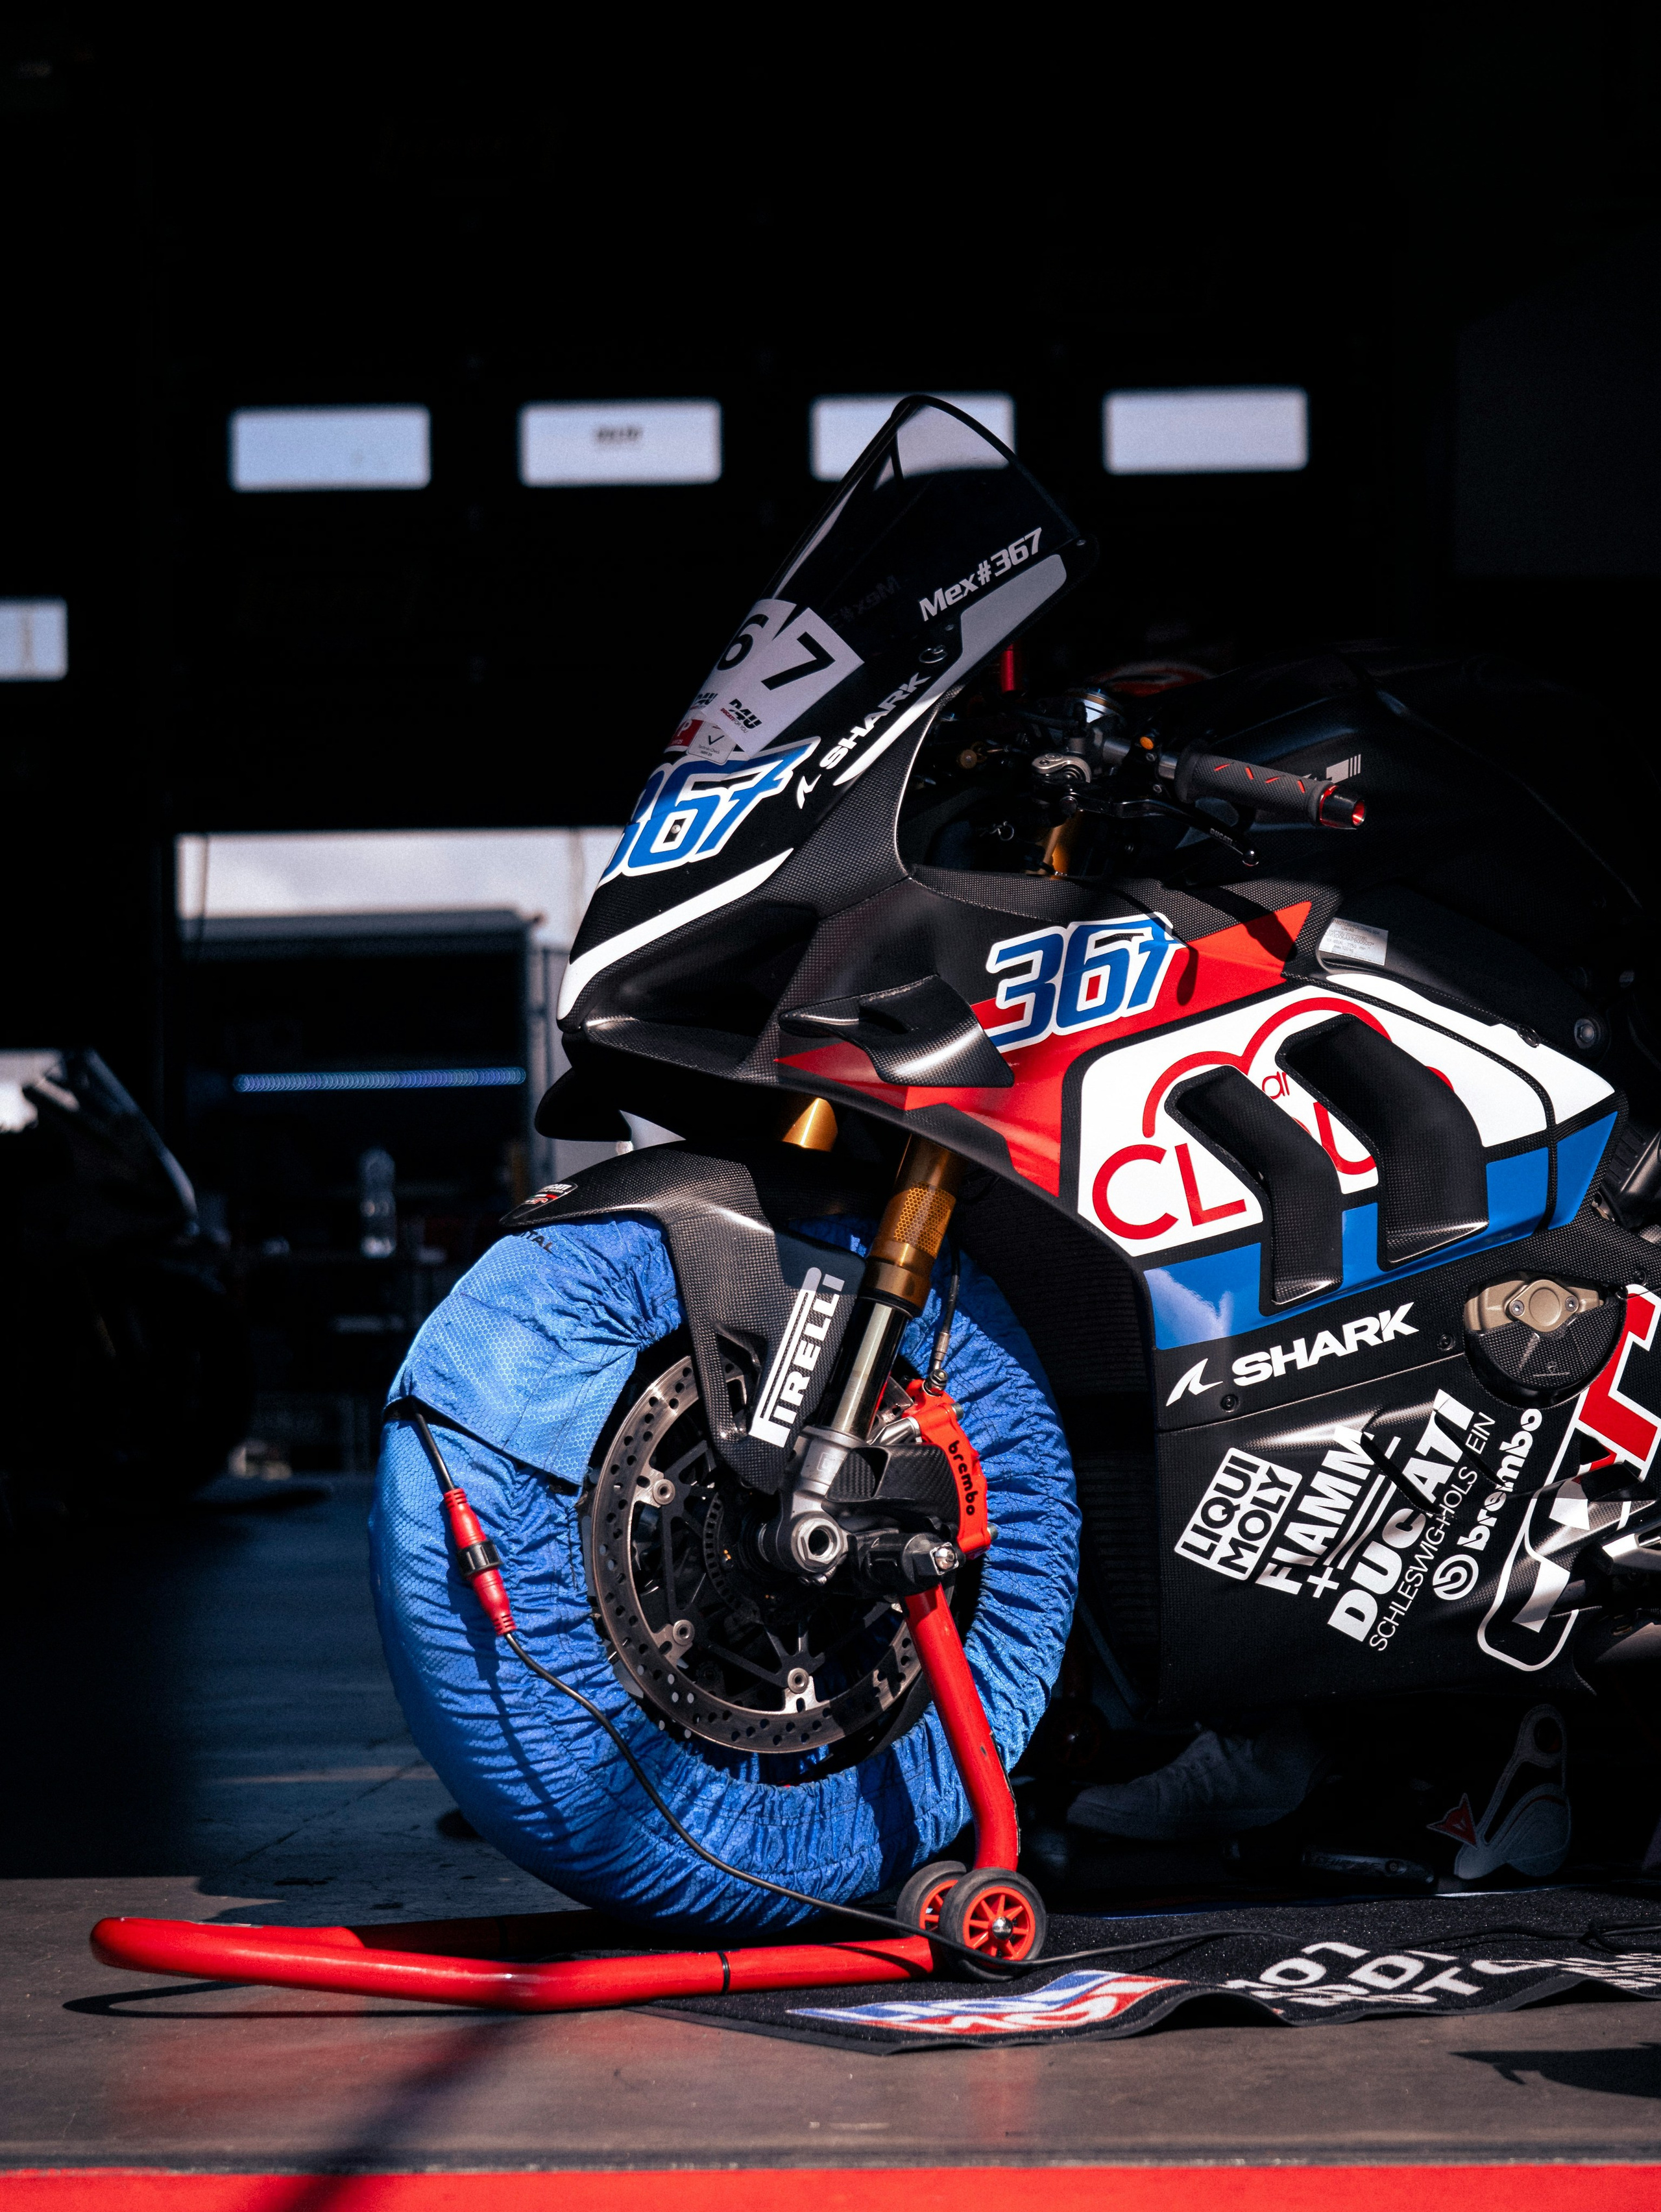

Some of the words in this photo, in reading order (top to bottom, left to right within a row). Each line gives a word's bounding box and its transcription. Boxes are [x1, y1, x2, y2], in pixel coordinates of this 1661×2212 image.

[919, 527, 1042, 621] Mex#367
[729, 699, 762, 729] D4U
[819, 673, 930, 770] SHARK
[986, 912, 1188, 1053] 367
[748, 1267, 845, 1448] PIRELLI
[1232, 1302, 1419, 1386] SHARK
[948, 1439, 975, 1516] brembo
[1181, 1457, 1261, 1563] LIQUI
[1218, 1465, 1293, 1575] MOLY
[1328, 1389, 1474, 1642] DUCATI
[1457, 1408, 1542, 1550] brembo
